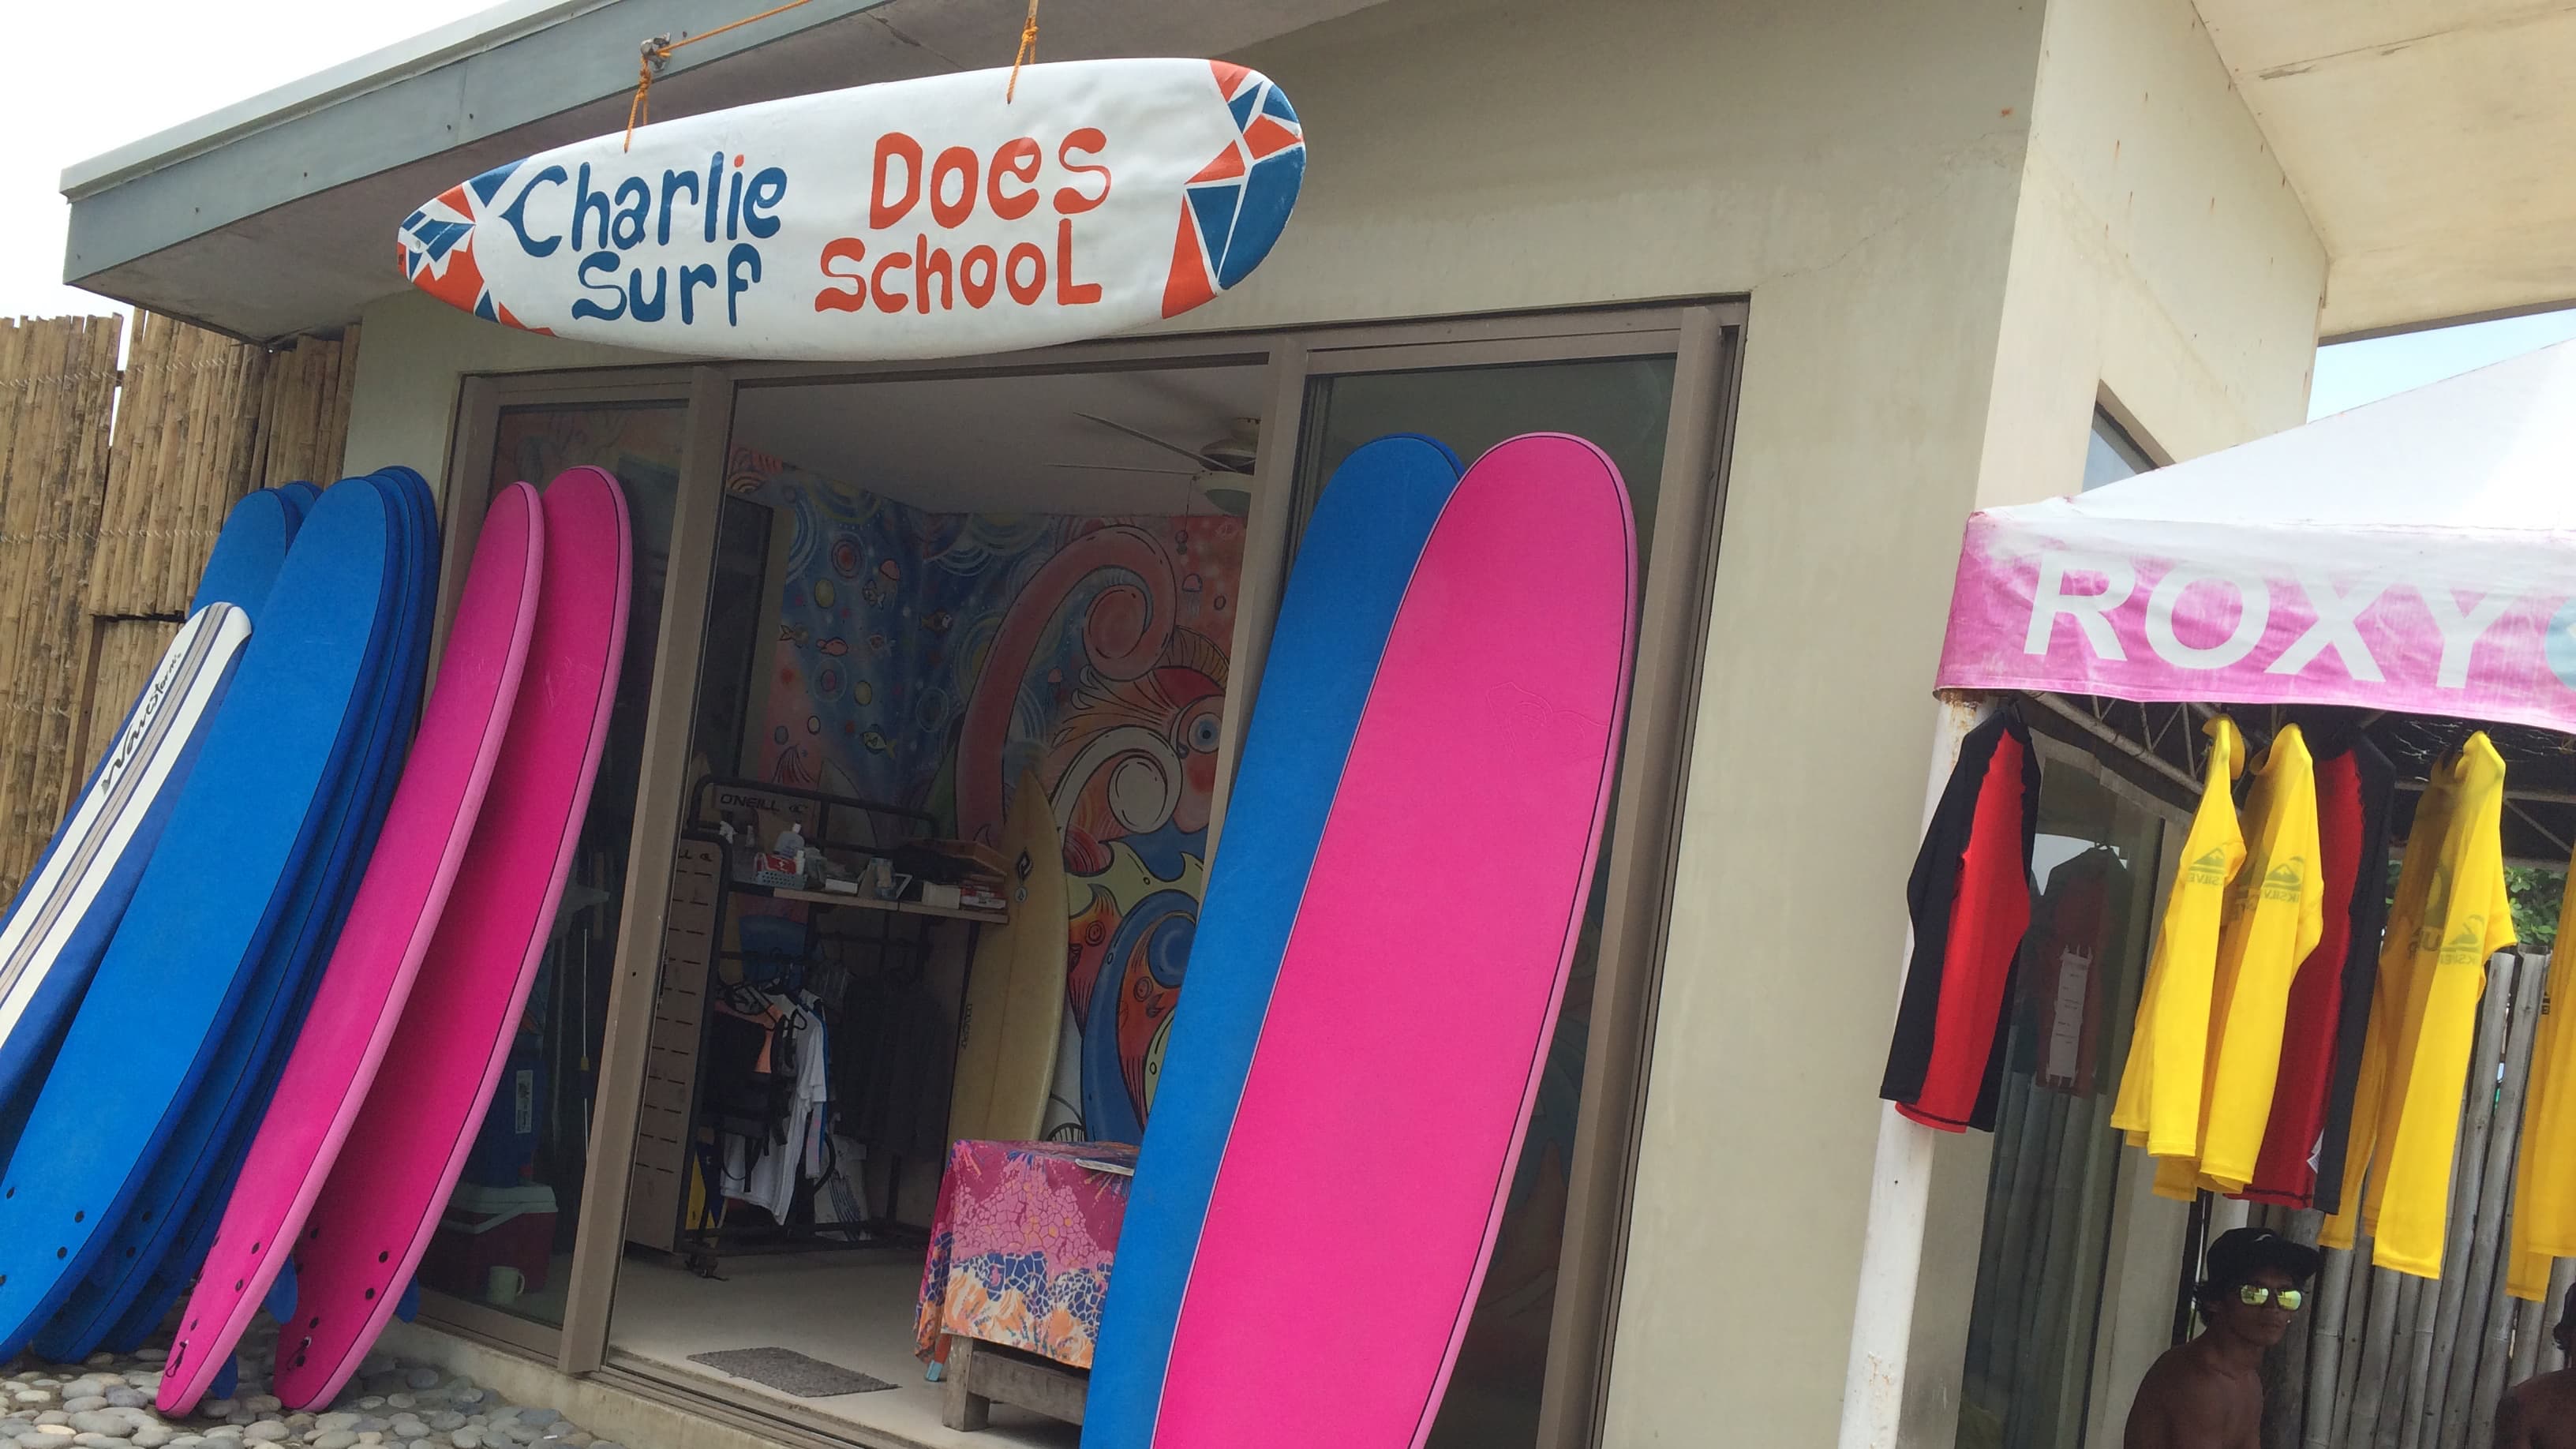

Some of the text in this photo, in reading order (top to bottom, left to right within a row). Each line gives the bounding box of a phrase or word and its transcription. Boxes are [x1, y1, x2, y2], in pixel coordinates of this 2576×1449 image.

[501, 126, 1111, 258] Charlie Does
[2023, 551, 2527, 689] ROXY
